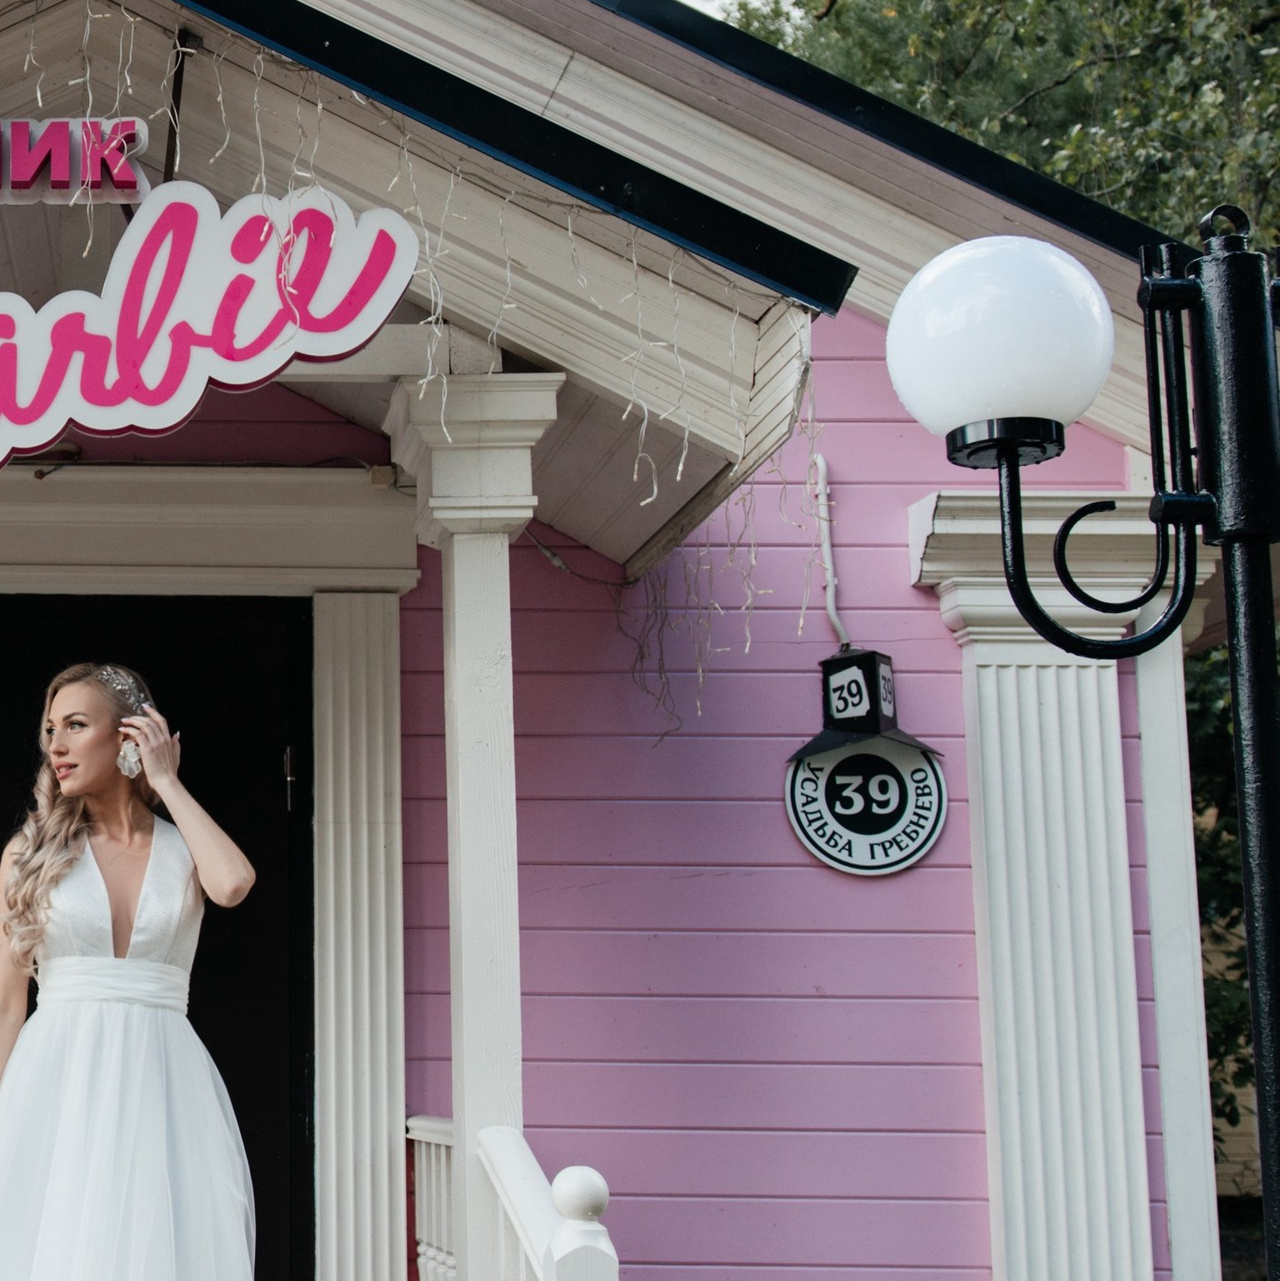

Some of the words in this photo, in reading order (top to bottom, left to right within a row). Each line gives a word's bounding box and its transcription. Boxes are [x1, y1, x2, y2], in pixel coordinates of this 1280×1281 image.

[832, 679, 863, 713] 39
[881, 674, 893, 705] 39
[801, 762, 853, 858] УСАДЬБА
[869, 768, 932, 860] ГРЕБНЕВО
[834, 773, 900, 815] 39
